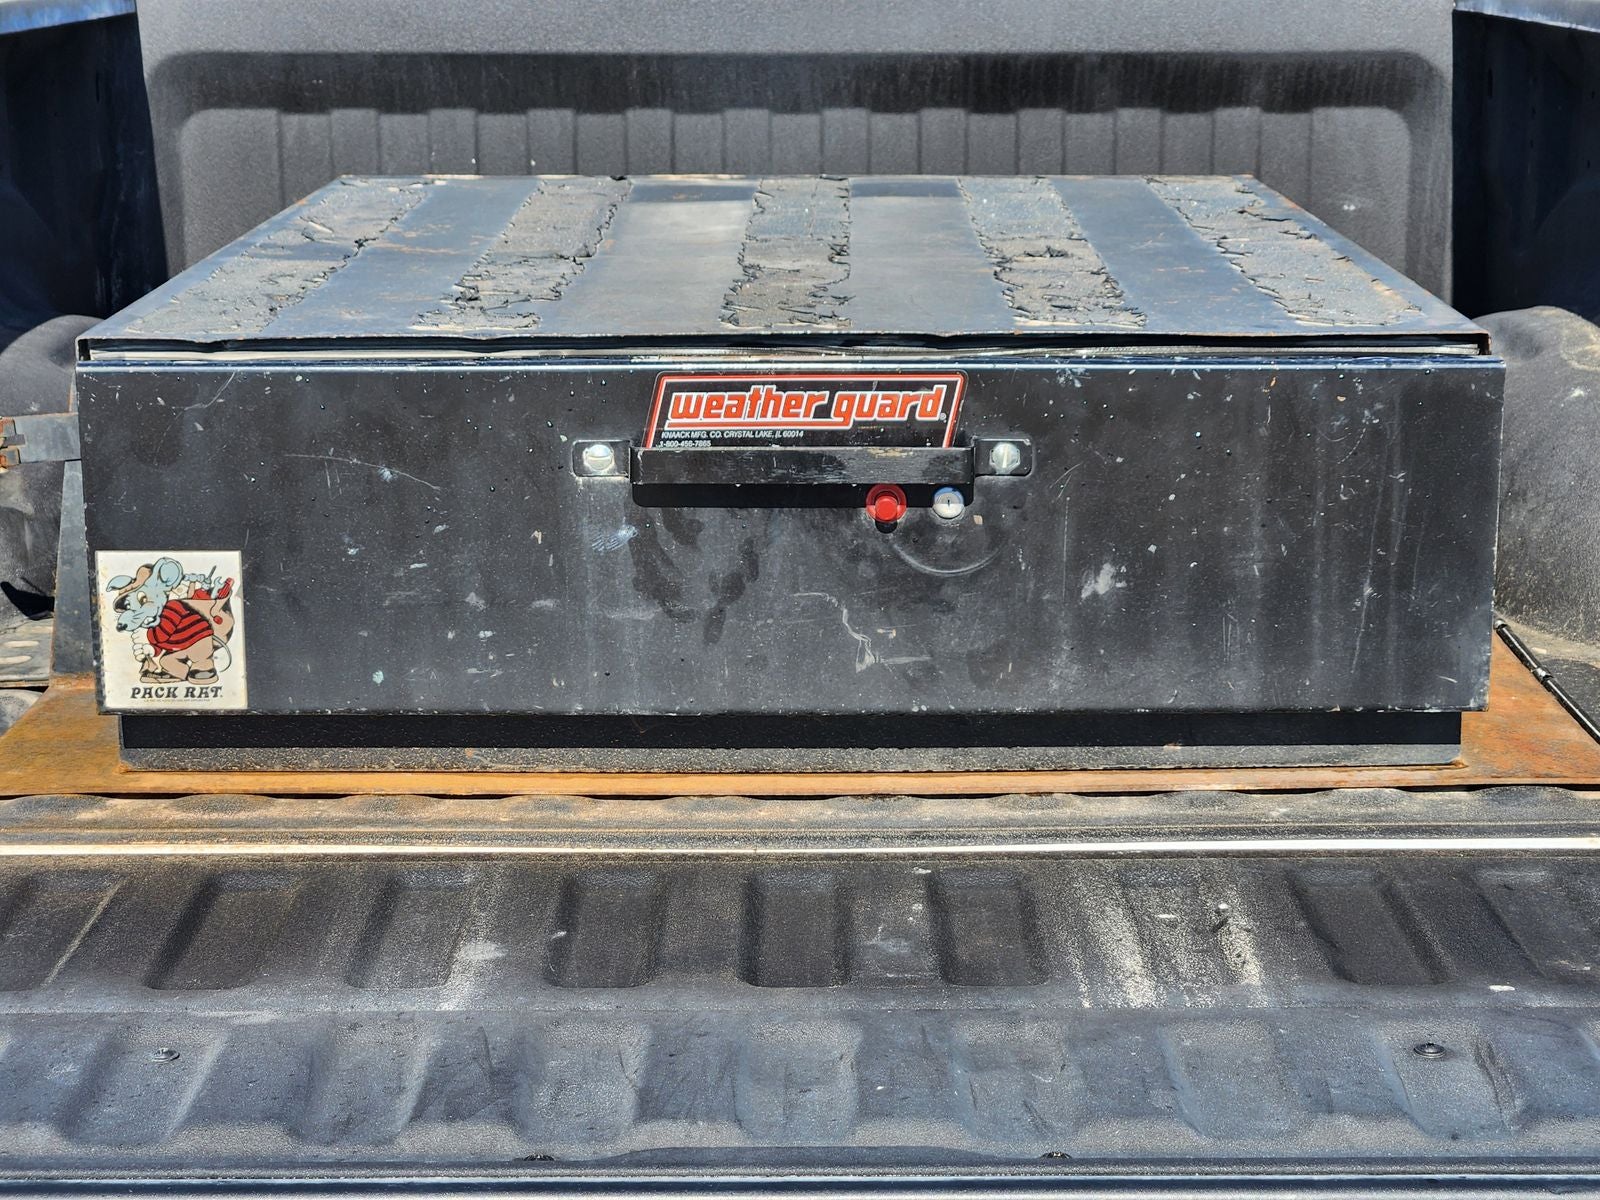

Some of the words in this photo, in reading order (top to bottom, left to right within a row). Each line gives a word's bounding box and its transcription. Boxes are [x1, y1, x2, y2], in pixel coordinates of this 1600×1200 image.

[667, 384, 829, 422] weather
[831, 384, 946, 428] guard
[661, 431, 691, 439] KNAACK
[691, 431, 708, 439] MFG.
[723, 430, 755, 438] CRYSTAL
[755, 430, 774, 438] LAKE,
[782, 430, 804, 438] 60014
[130, 686, 178, 699] PACK
